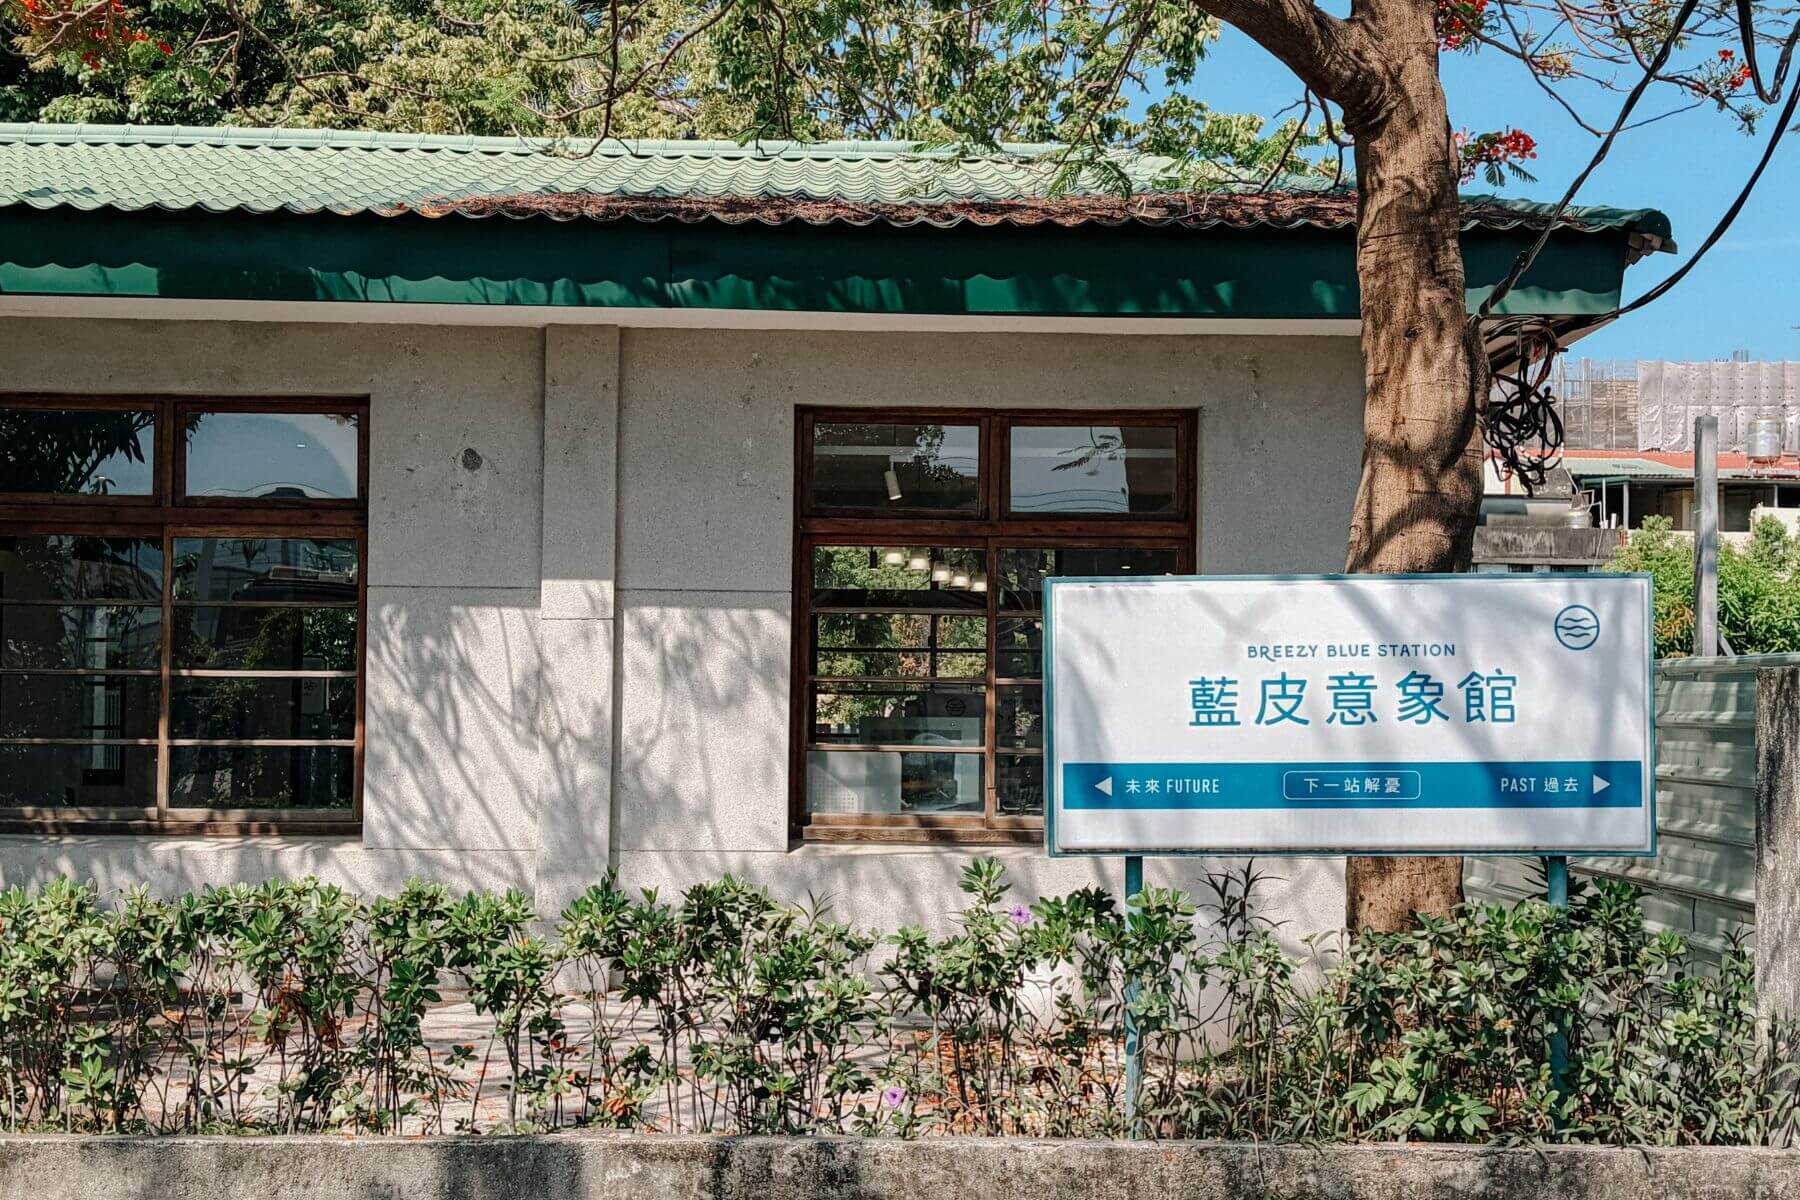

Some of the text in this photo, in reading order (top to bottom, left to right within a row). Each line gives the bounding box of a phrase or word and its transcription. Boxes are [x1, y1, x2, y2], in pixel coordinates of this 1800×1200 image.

[1247, 643, 1456, 662] BREEZY BLUE STATION
[1188, 668, 1517, 726] 藍皮意象館
[1125, 778, 1220, 794] 未來 FUTURE
[1303, 777, 1401, 793] 下一站解憂
[1500, 777, 1579, 793] PAST 過去
